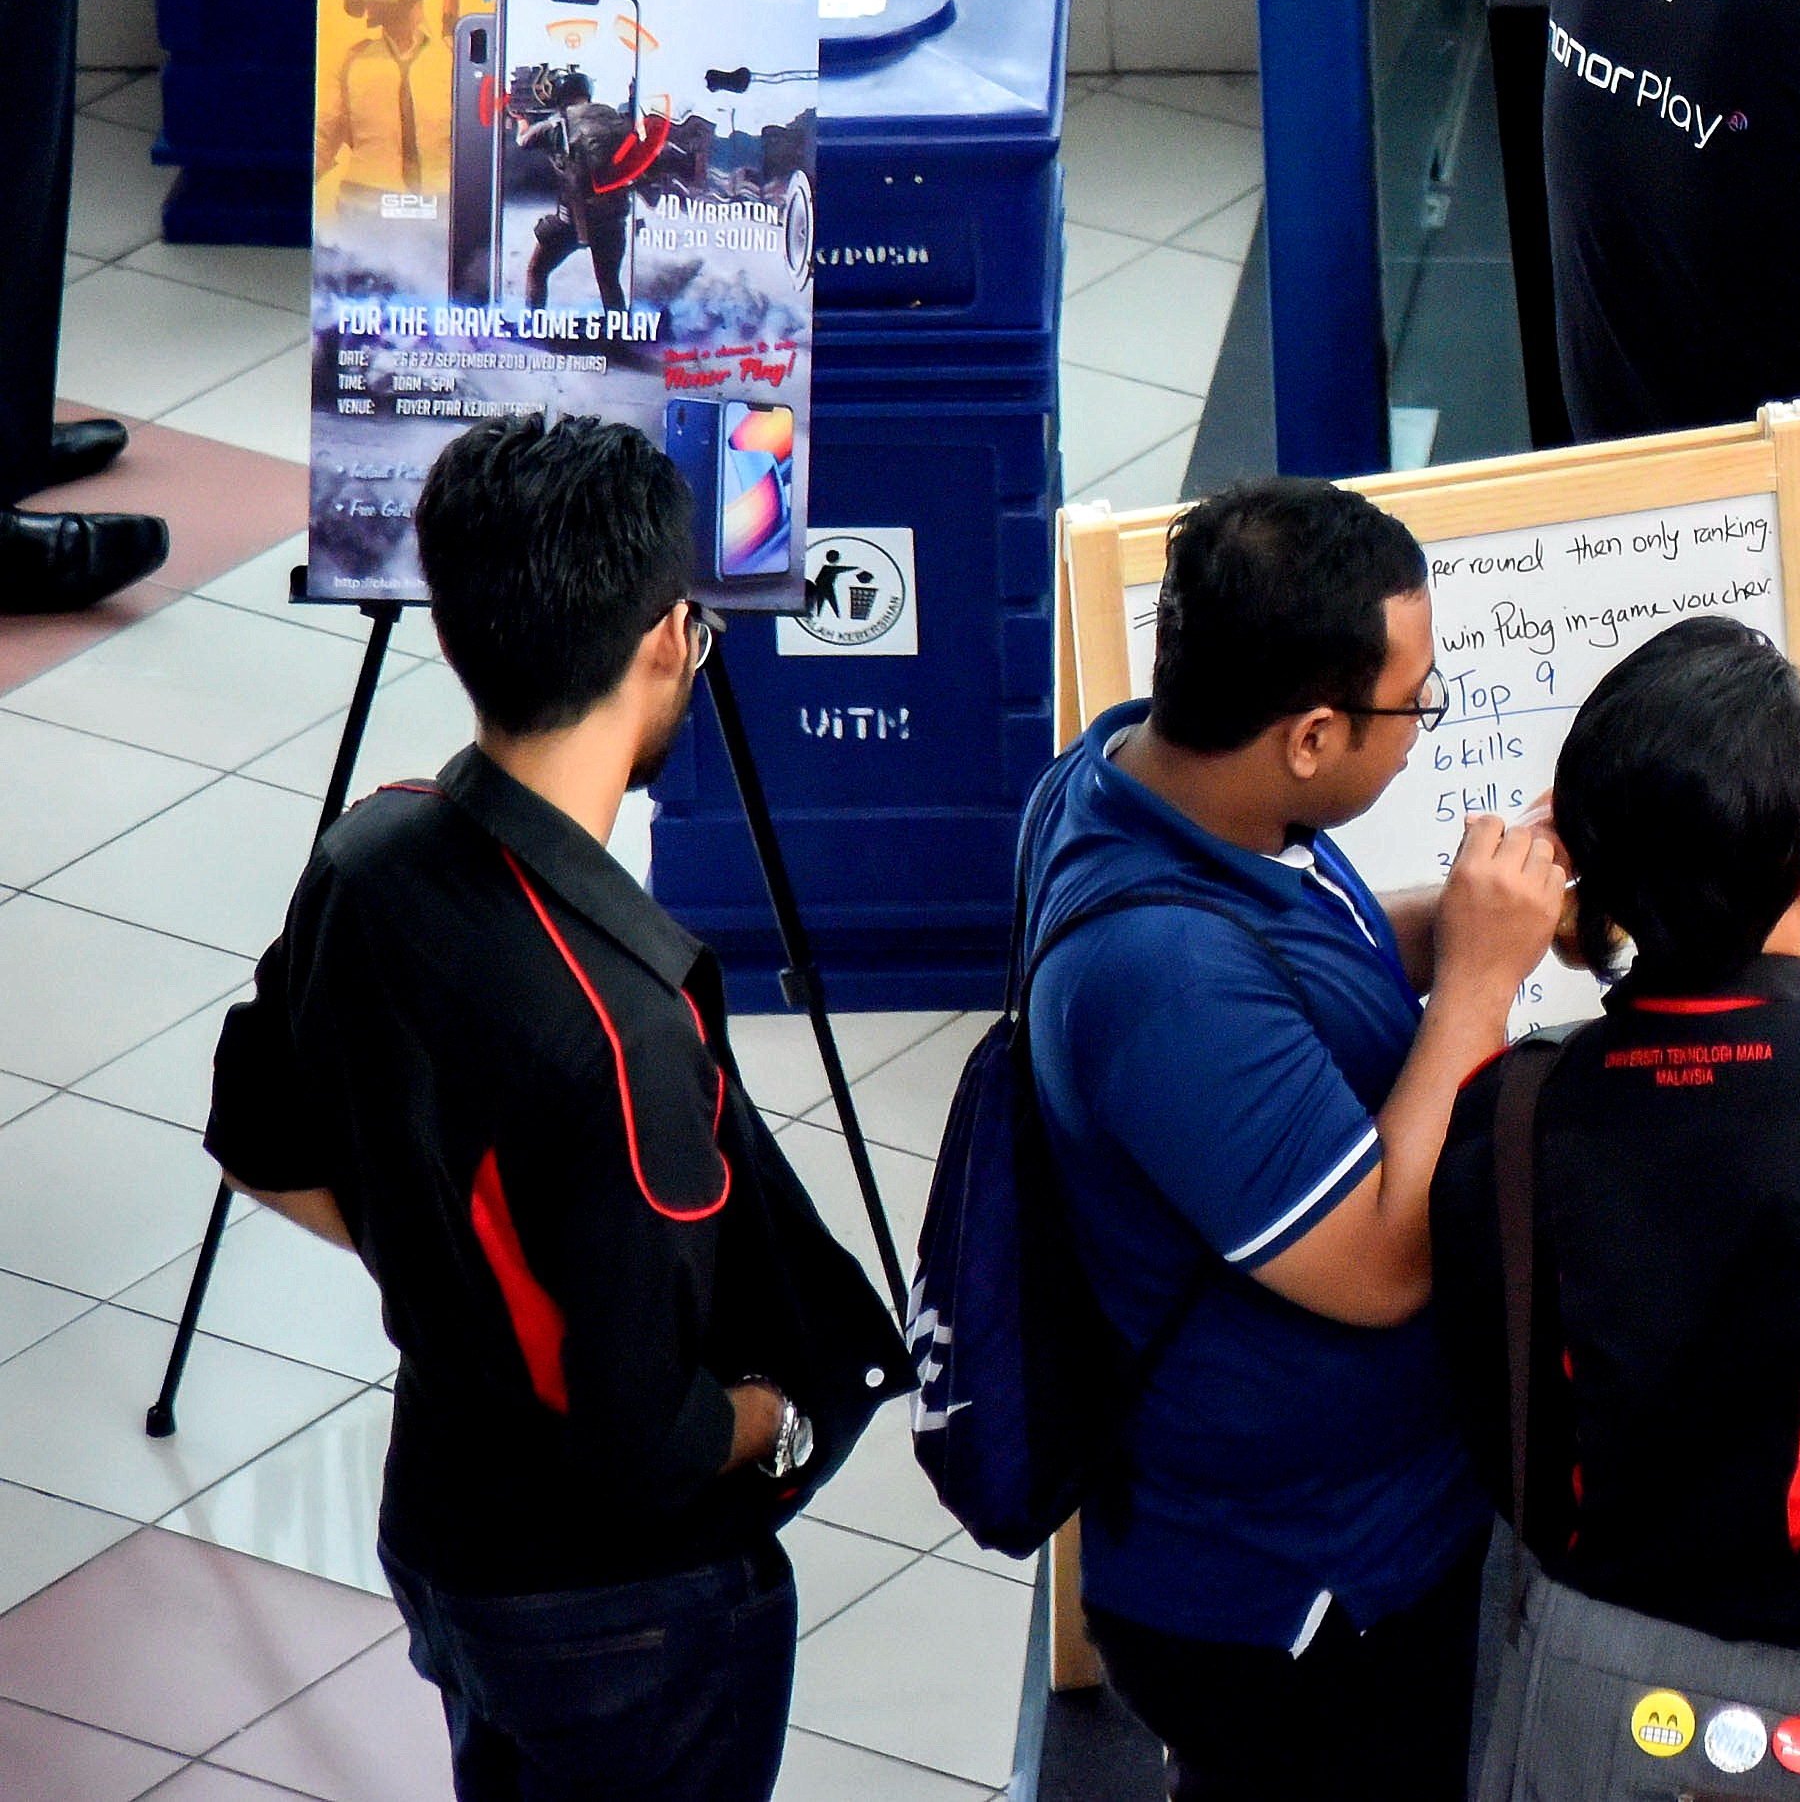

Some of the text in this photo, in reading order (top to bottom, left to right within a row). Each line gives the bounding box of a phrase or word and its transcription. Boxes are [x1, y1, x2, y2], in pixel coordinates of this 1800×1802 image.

[1636, 70, 1724, 149] Play
[381, 194, 438, 207] GPU
[656, 194, 681, 219] 4D
[639, 226, 778, 252] AND 3D SOUND
[338, 306, 662, 342] FOR THE BRAVE. COME & PLAY
[337, 350, 370, 367] DATE:
[420, 353, 435, 369] 27
[435, 353, 497, 371] SEPTEMBER
[499, 354, 527, 370] 2018
[529, 355, 557, 374] (WED
[567, 356, 608, 375] THURS)
[337, 374, 367, 391] TIME:
[392, 375, 422, 392] 10AM
[431, 376, 456, 393] 5PM
[337, 399, 376, 416] VENUE:
[396, 398, 432, 416] FOYER
[432, 399, 462, 417] PTAR
[1431, 514, 1773, 589] per round then only ranking.
[1442, 628, 1485, 652] win
[1491, 600, 1555, 655] Pubg
[1671, 576, 1773, 614] voucher.
[1448, 660, 1556, 726] Top 9
[1603, 1043, 1773, 1069] UNIVERSITI TEKNOLOGI MARA
[1655, 1068, 1714, 1087] MALAYSIA
